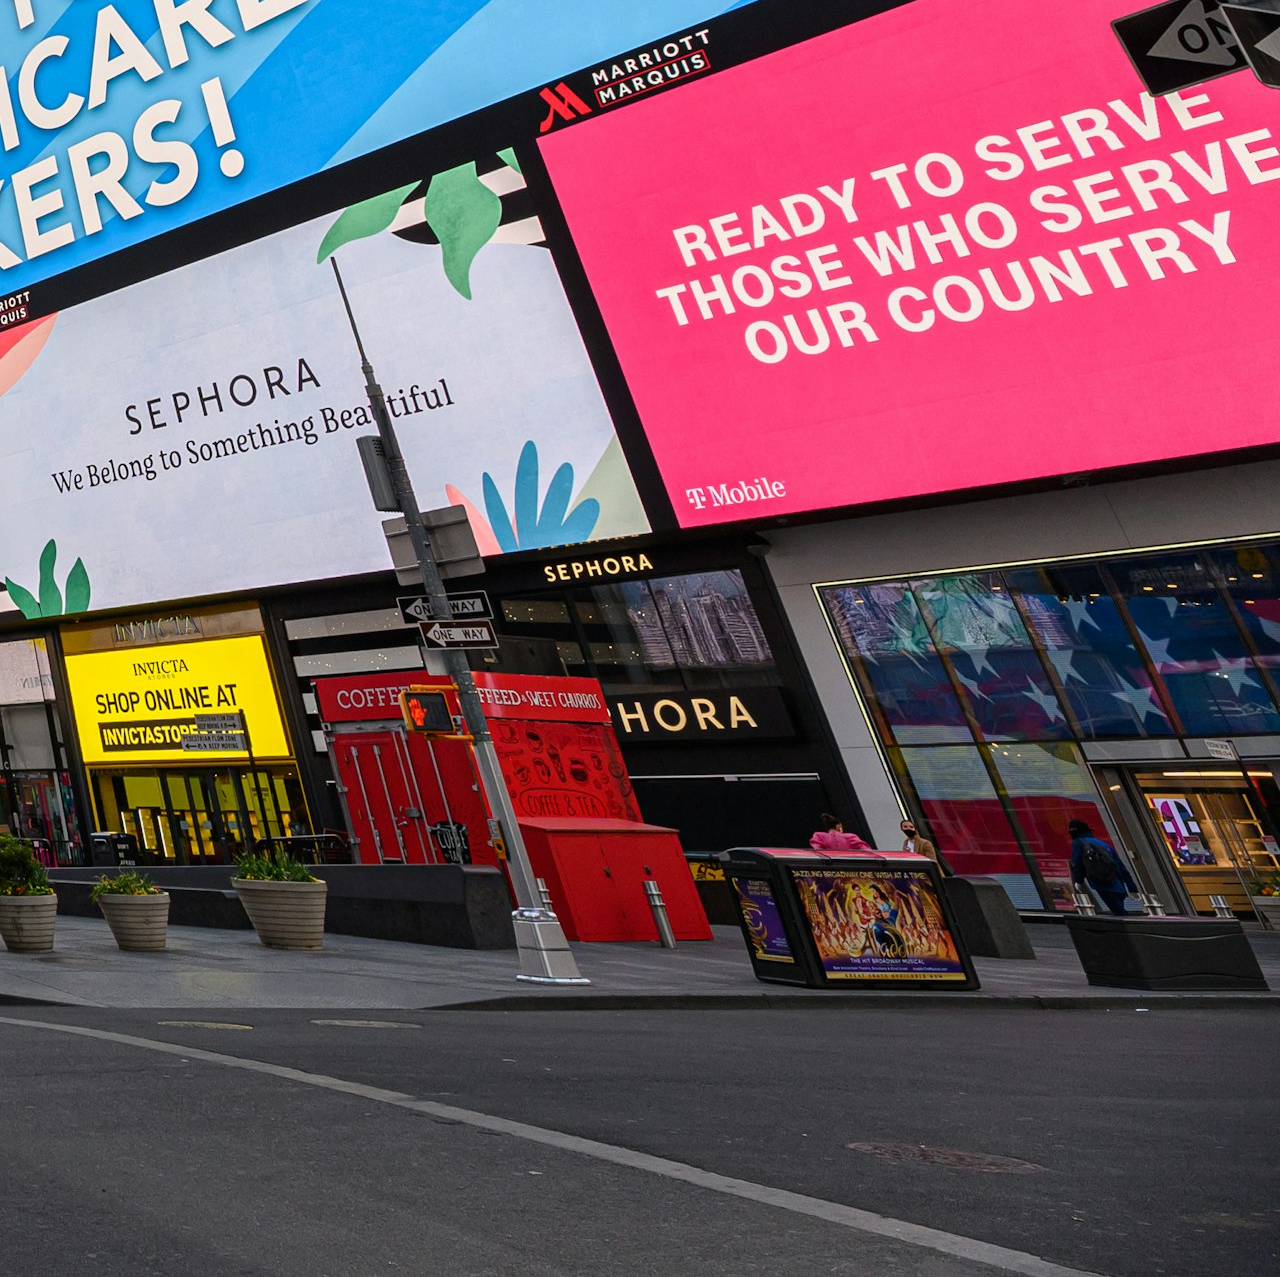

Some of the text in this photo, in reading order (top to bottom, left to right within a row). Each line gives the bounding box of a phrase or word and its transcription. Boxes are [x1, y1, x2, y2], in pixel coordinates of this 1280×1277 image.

[592, 28, 711, 85] MARRIOTT
[599, 51, 707, 106] MARQUIS
[671, 83, 1225, 268] READY TO SERVE
[655, 123, 1280, 327] THOSE WHO SERVE
[744, 210, 1237, 366] OUR COUNTRY
[125, 357, 321, 435] SEPHORA
[51, 466, 85, 495] We
[86, 450, 158, 490] Belong
[157, 446, 183, 472] to
[186, 415, 319, 466] Something
[543, 554, 653, 583] SEPHORA
[113, 614, 201, 643] INVICTA
[433, 629, 485, 641] ONE WAY
[132, 659, 189, 676] INVICTA
[147, 673, 176, 681] STORES
[96, 683, 237, 714] SHOP ONLINE AT
